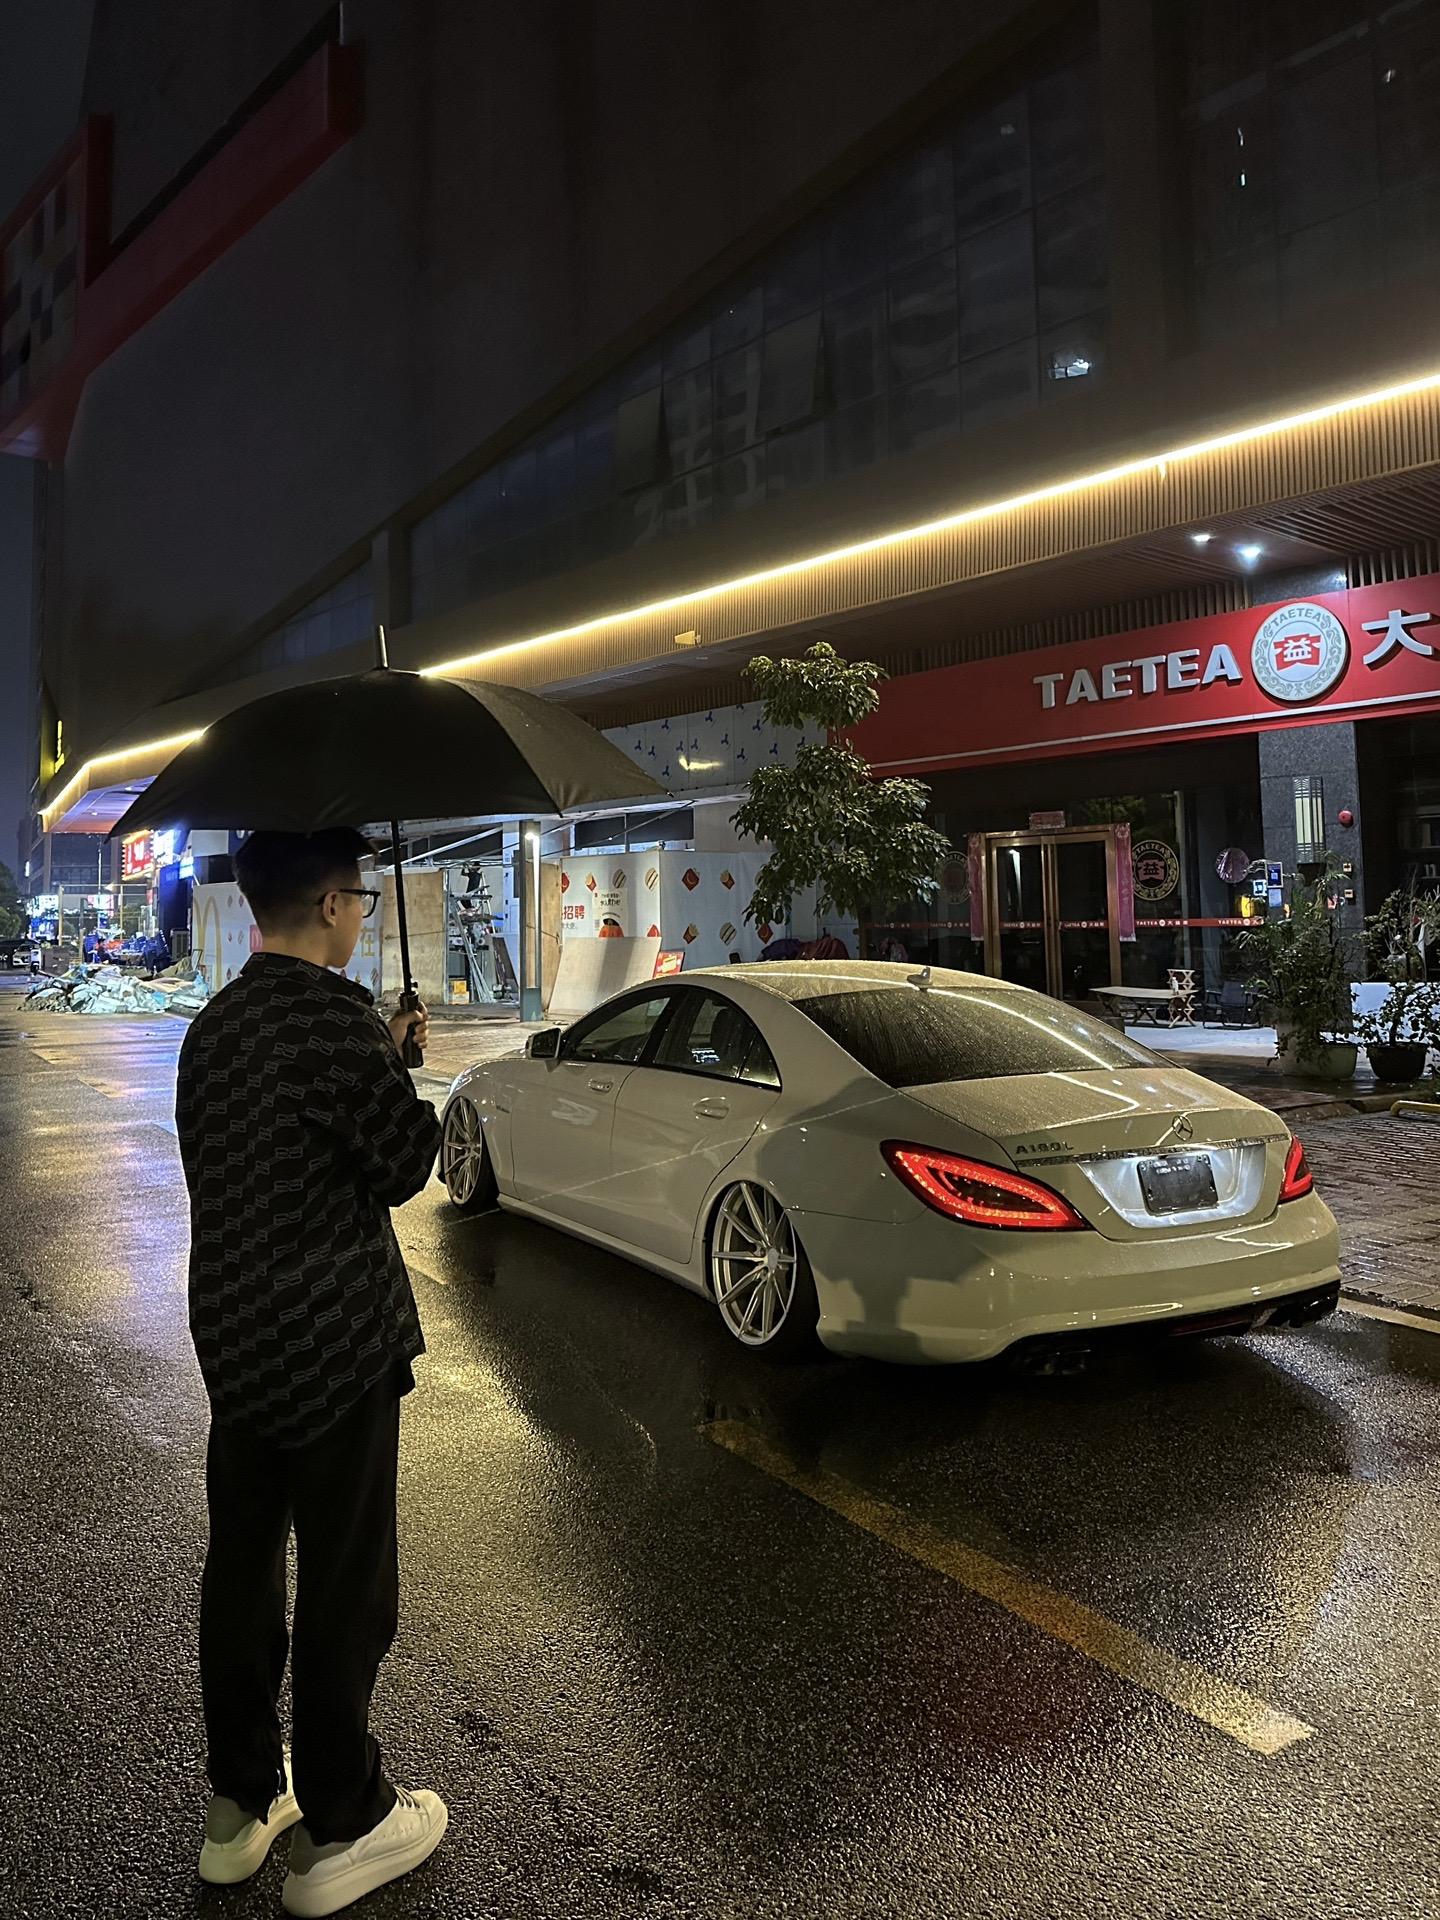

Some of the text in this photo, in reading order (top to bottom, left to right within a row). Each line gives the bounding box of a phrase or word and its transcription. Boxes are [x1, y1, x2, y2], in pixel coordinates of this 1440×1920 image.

[1271, 607, 1321, 627] TAETEA
[1284, 637, 1312, 662] 益
[1361, 609, 1433, 665] 大
[1033, 643, 1242, 709] TAETEA
[562, 904, 585, 920] 招聘
